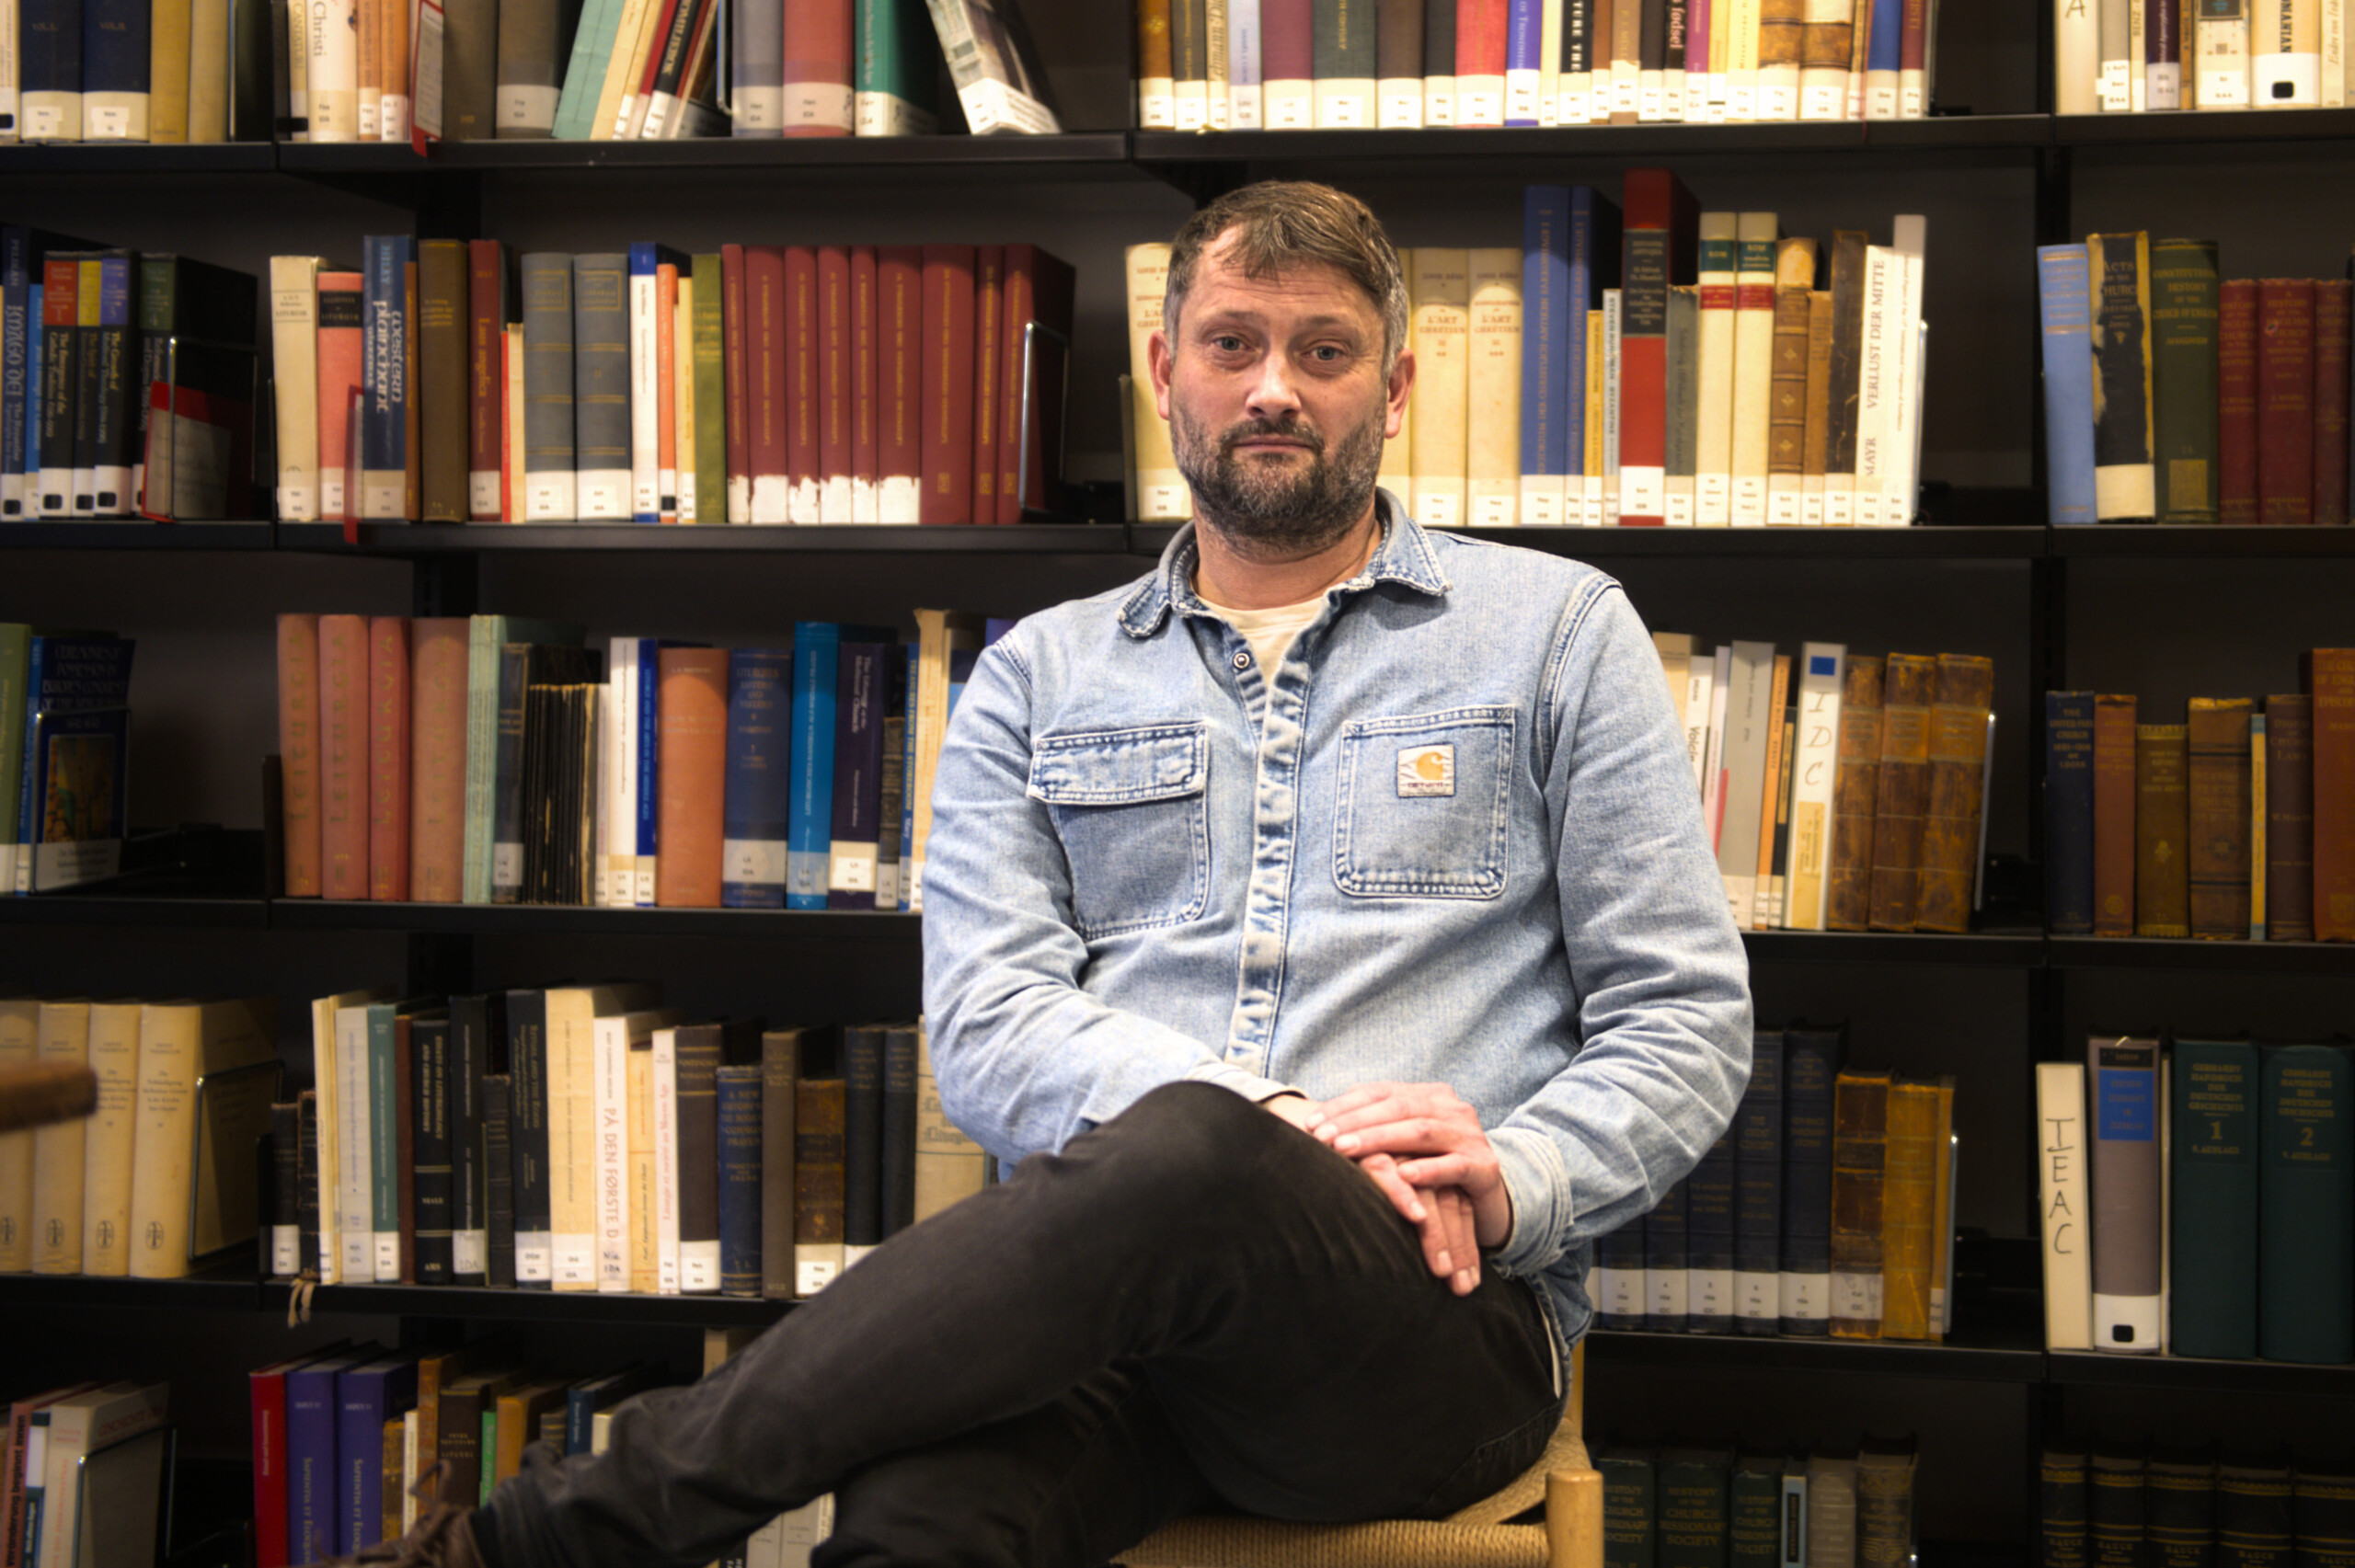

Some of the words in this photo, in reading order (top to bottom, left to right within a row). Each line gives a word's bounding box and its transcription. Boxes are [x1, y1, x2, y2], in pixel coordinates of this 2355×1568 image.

[313, 1, 327, 57] Christi
[1669, 6, 1685, 49] fødsel
[9, 239, 21, 287] PELIKAN
[379, 246, 390, 285] HILEY
[2104, 261, 2134, 272] ACTS
[1870, 260, 1885, 306] MITTE
[2168, 282, 2207, 292] HISTORY
[2268, 300, 2306, 308] HISTORY
[477, 318, 491, 346] Laus
[1869, 311, 1882, 338] DER
[5, 305, 26, 365] IMAGO
[58, 332, 68, 347] The
[110, 332, 121, 347] The
[109, 349, 121, 377] Growth
[373, 301, 391, 414] plainchant
[390, 311, 403, 403] western
[475, 349, 491, 397] angelica
[1867, 343, 1881, 409] VERLUST
[58, 389, 68, 400] of
[58, 402, 68, 415] the
[908, 658, 918, 708] TREASURES
[329, 633, 350, 823] LEITURGIA
[373, 635, 396, 825] LEITURGIA
[907, 709, 916, 735] FROM
[2056, 730, 2089, 739] CHURCH
[906, 737, 915, 753] THE
[2192, 1063, 2242, 1073] GEBHARDT
[2282, 1069, 2332, 1079] GEBHARDT
[2191, 1073, 2243, 1082] HANDBUCH
[2280, 1079, 2333, 1089] HANDBUCH
[2208, 1082, 2226, 1092] DER
[2297, 1089, 2315, 1098] DER
[2190, 1092, 2243, 1102] DEUTSCHEN
[2280, 1098, 2333, 1107] DEUTSCHEN
[2188, 1101, 2245, 1112] GESCHICHTE
[2278, 1107, 2335, 1118] GESCHICHTE
[603, 1107, 617, 1128] PÅ
[2211, 1121, 2223, 1140] 1
[2300, 1127, 2314, 1146] 2
[604, 1133, 617, 1162] DEN
[2201, 1145, 2240, 1154] AUFLAGE
[2292, 1151, 2331, 1161] AUFLAGE
[604, 1168, 619, 1223] FØRSTE
[14, 1414, 26, 1447] innen
[11, 1449, 24, 1494] beginnt
[303, 1457, 314, 1504] SAPIENTIA
[353, 1458, 363, 1505] SAPIENTIA
[1667, 1486, 1718, 1497] HISTORY
[304, 1506, 313, 1517] ET
[353, 1508, 362, 1519] ET
[1666, 1508, 1719, 1519] CHURCH
[1735, 1516, 1776, 1528] CHURCH
[303, 1519, 314, 1566] ELOQUEN
[1666, 1534, 1718, 1546] SOCIETY
[1734, 1543, 1777, 1553] SOCIETY
